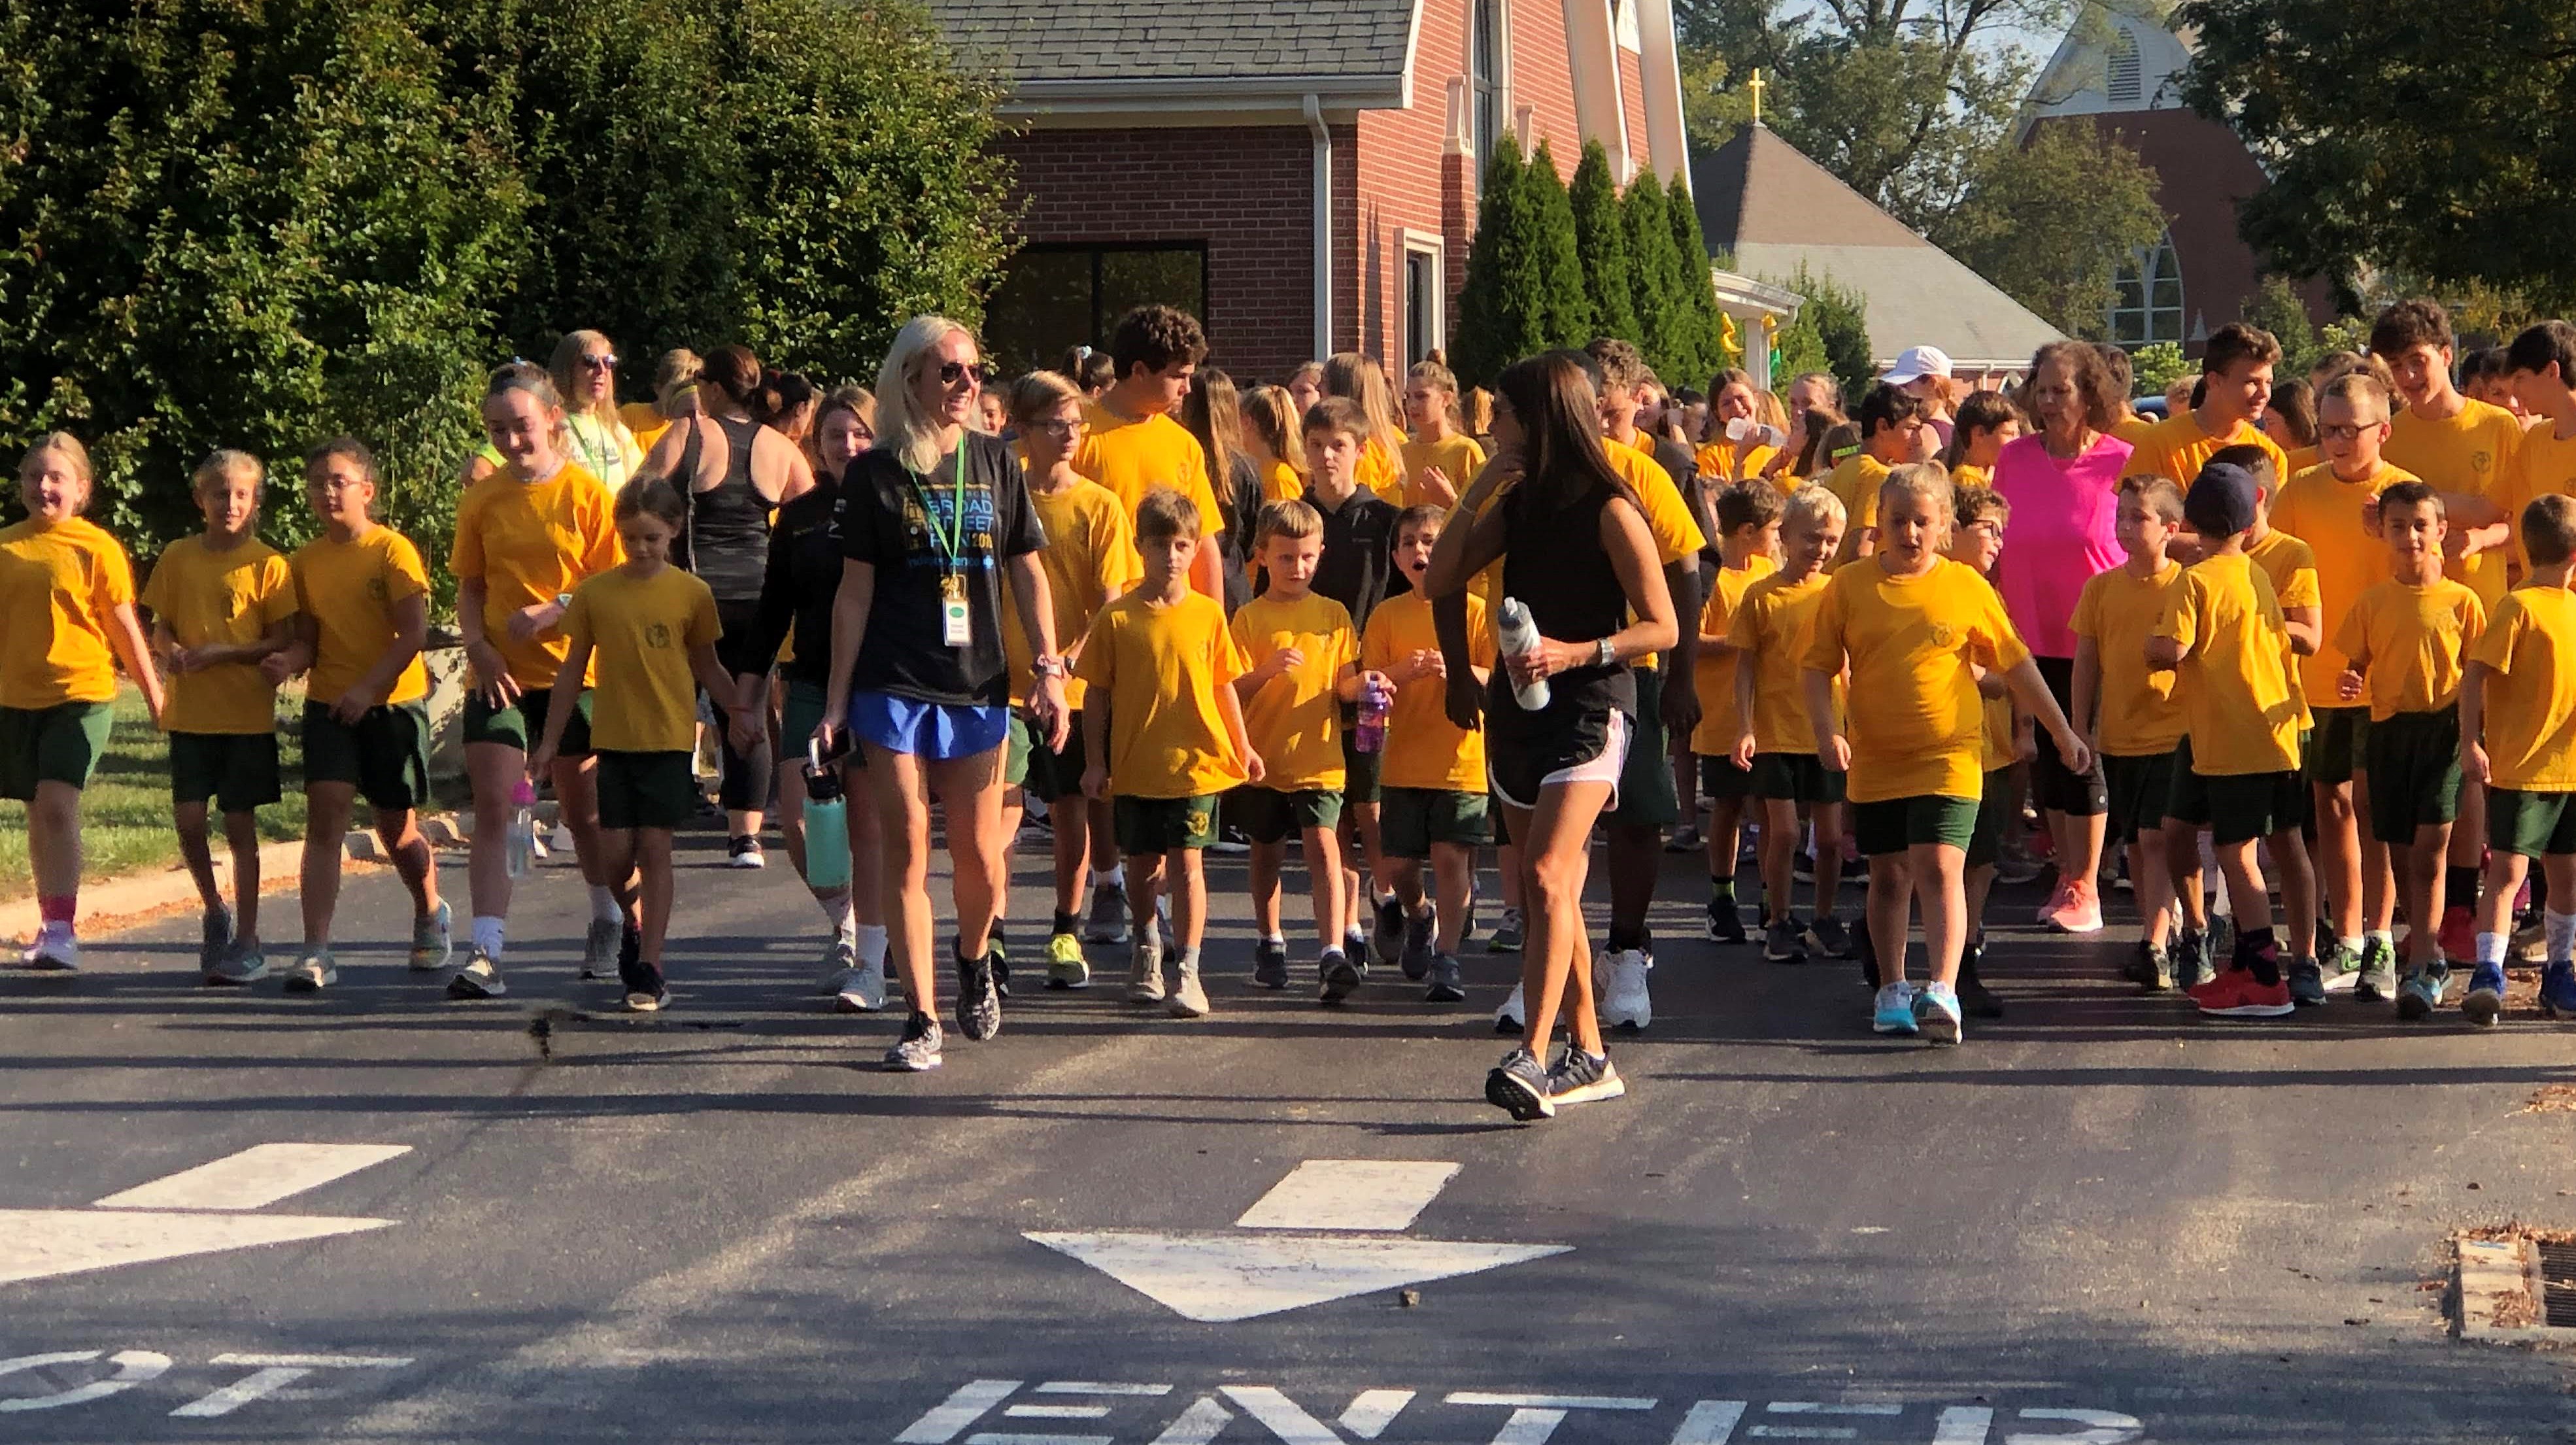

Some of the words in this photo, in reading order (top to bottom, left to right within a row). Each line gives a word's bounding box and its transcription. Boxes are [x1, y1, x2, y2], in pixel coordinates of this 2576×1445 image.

[928, 515, 994, 532] TEET
[929, 532, 970, 548] RN
[893, 1379, 2145, 1445] ENTER
